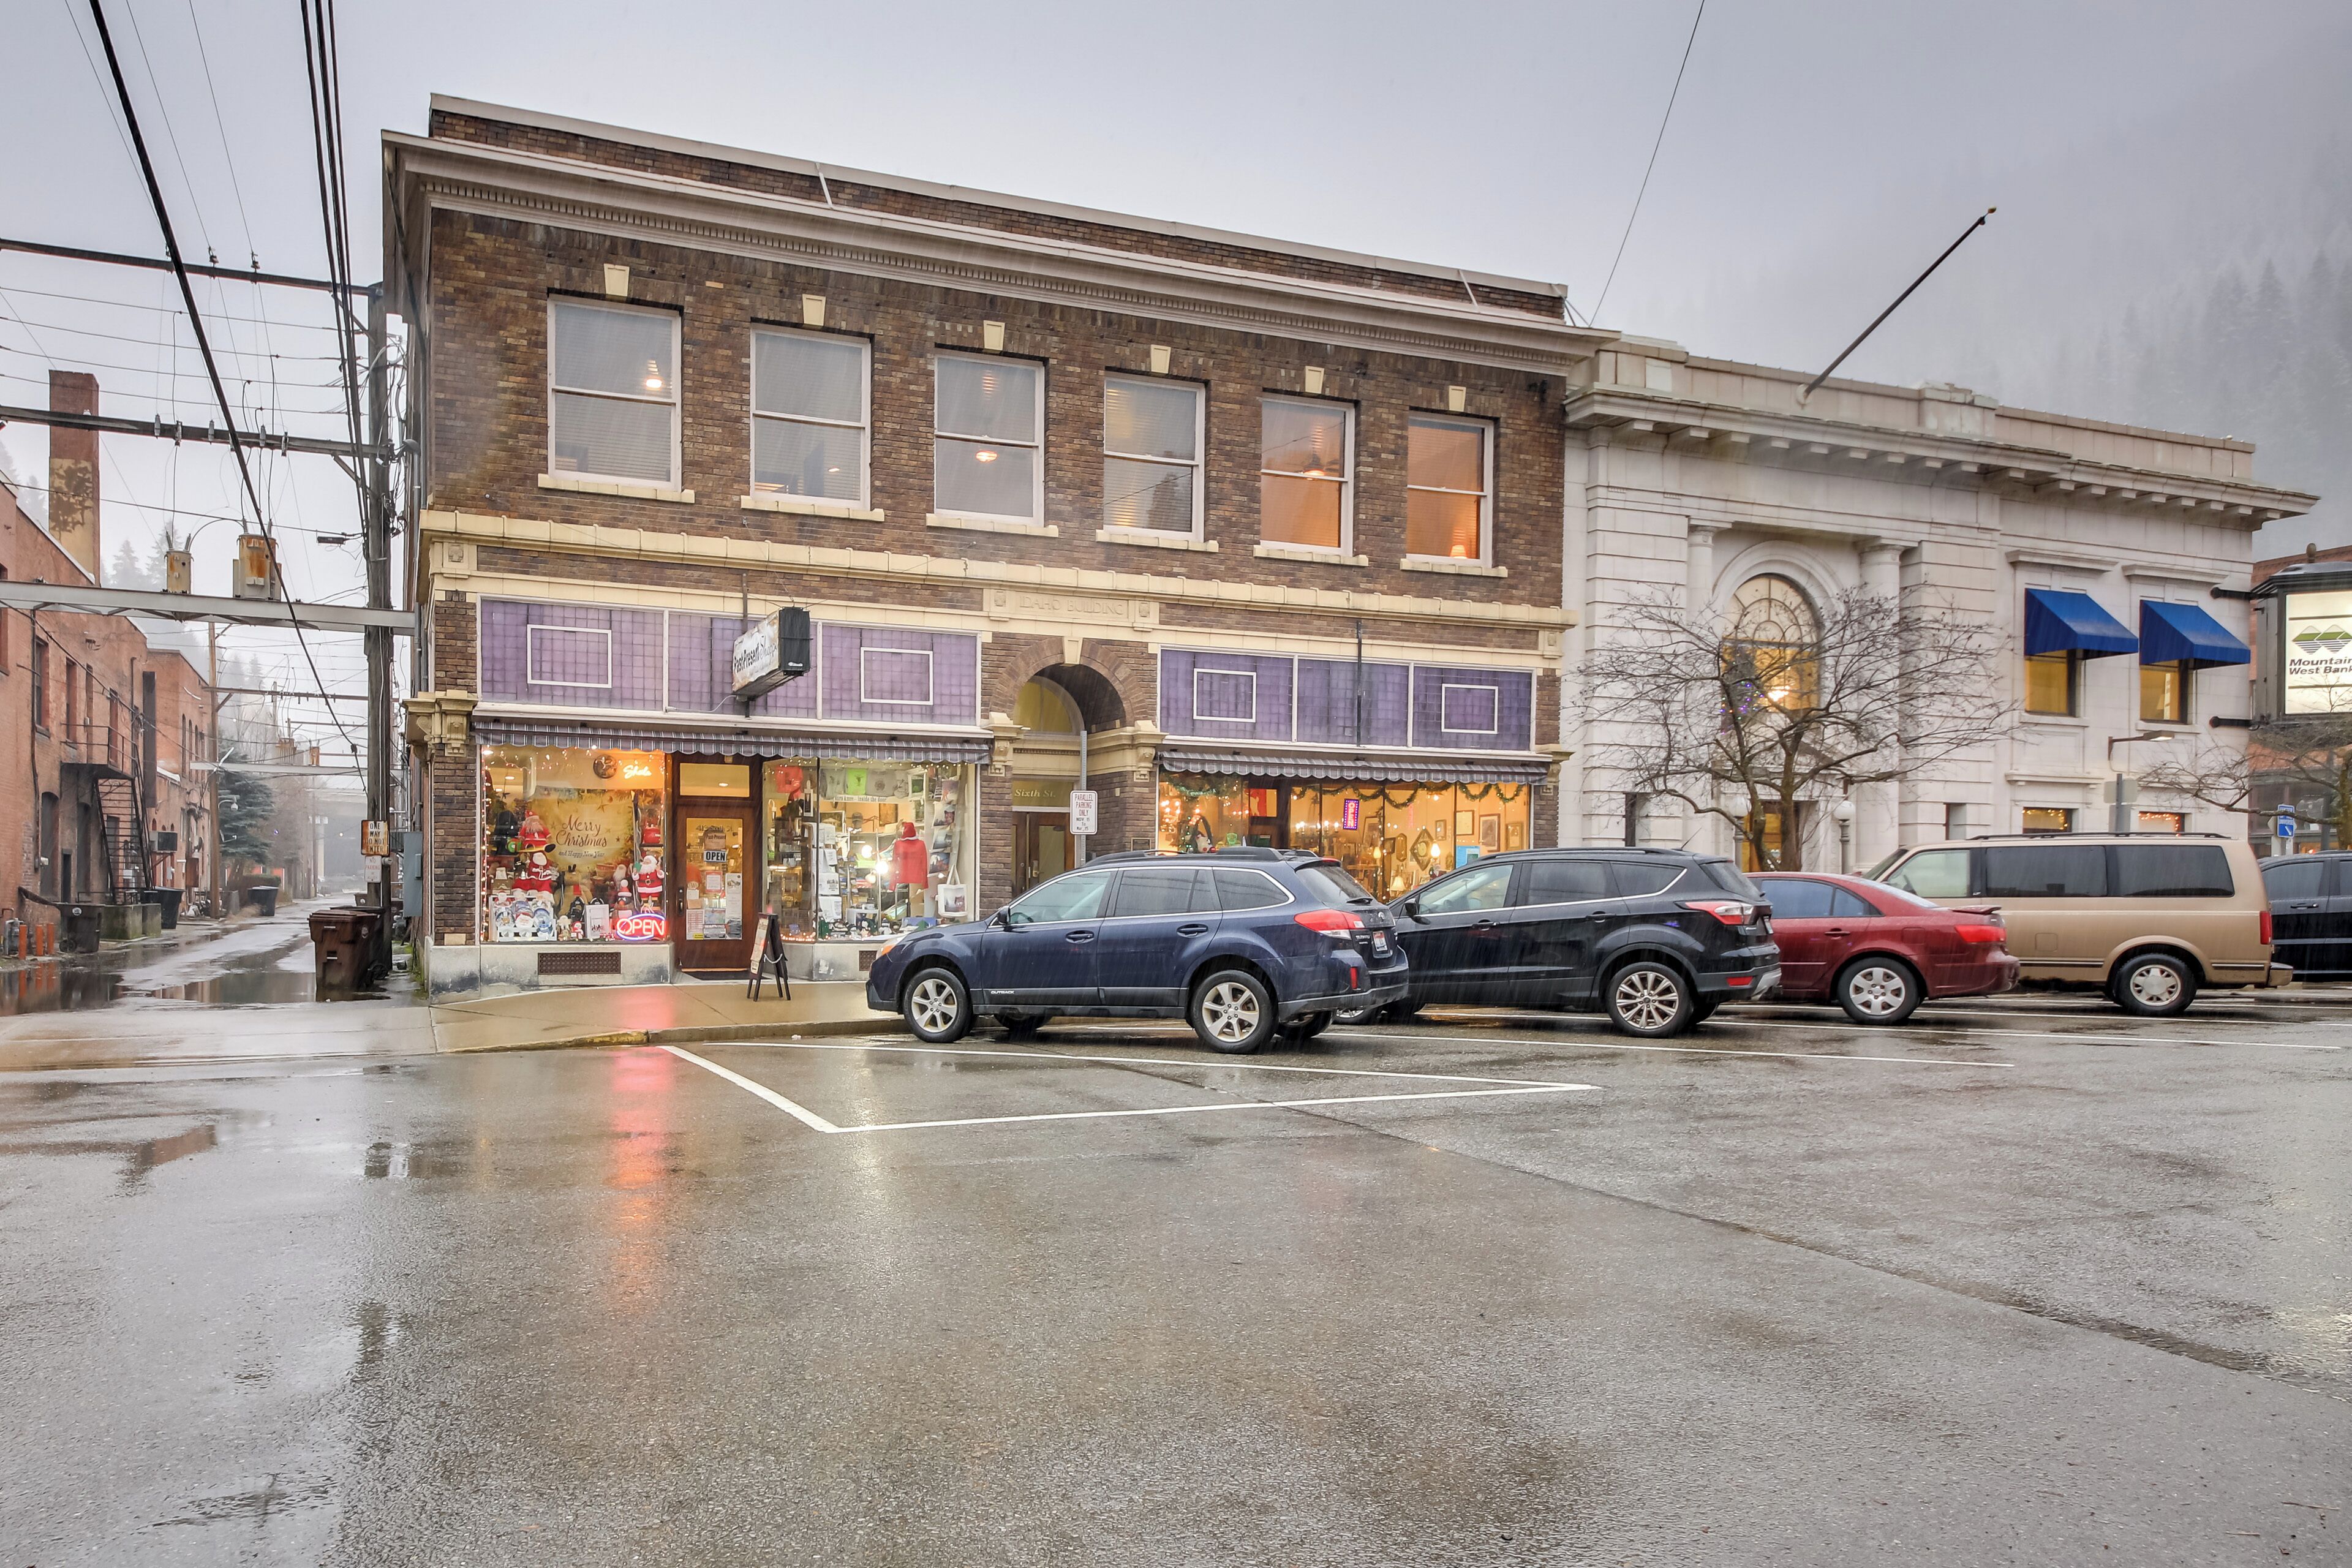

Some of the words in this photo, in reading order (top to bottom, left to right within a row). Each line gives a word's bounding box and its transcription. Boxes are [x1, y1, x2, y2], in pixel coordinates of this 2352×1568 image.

[1019, 595, 1061, 611] IDAHO
[1067, 599, 1124, 615] BUILDING
[743, 643, 760, 669] Present
[2289, 666, 2320, 675] West
[1014, 789, 1041, 797] Sixth
[1348, 802, 1356, 827] OPEN
[562, 815, 601, 837] Merry
[556, 830, 607, 848] Christmas
[706, 851, 726, 861] OPEN
[617, 918, 665, 936] OPEN
